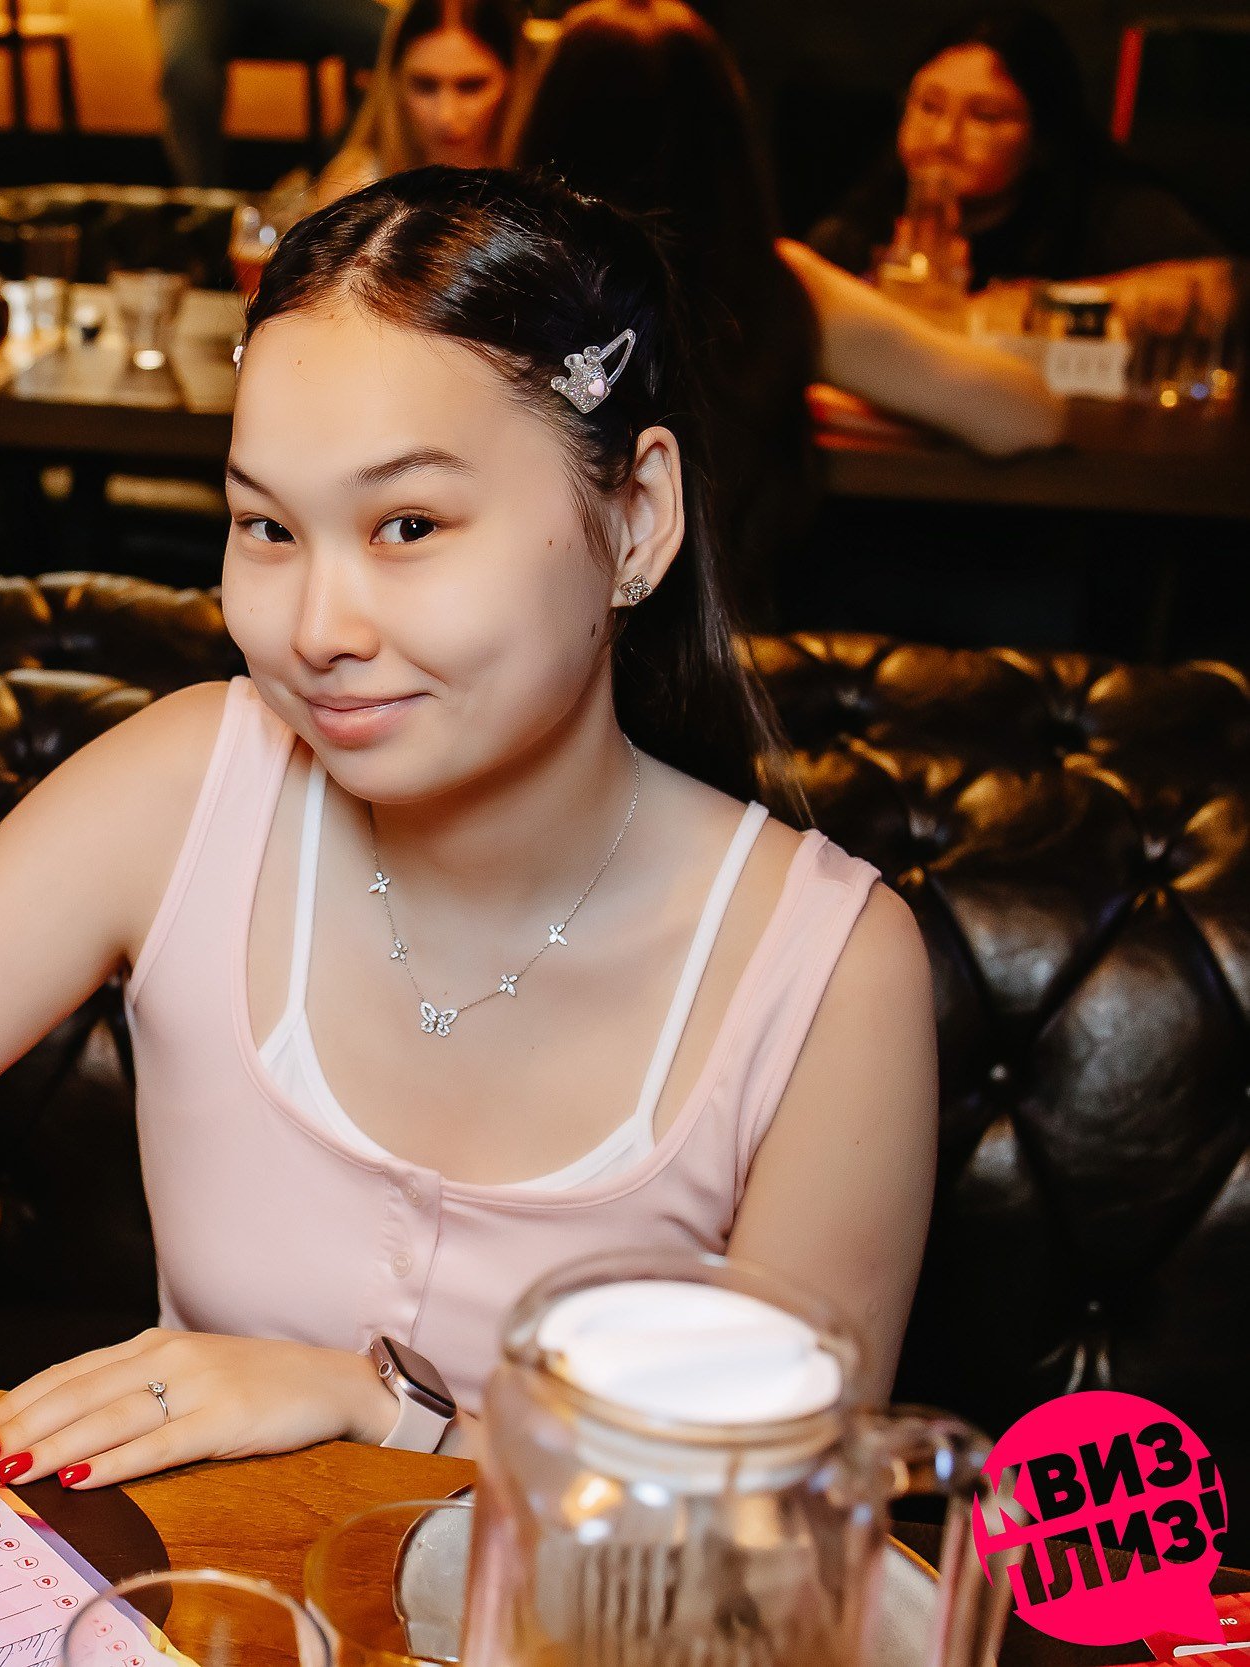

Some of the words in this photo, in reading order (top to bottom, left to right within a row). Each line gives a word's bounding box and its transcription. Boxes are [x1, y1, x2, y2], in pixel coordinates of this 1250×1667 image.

[3, 1541, 14, 1549] 8
[24, 1559, 33, 1567] 7
[42, 1578, 52, 1586] 6
[61, 1598, 73, 1607] 5
